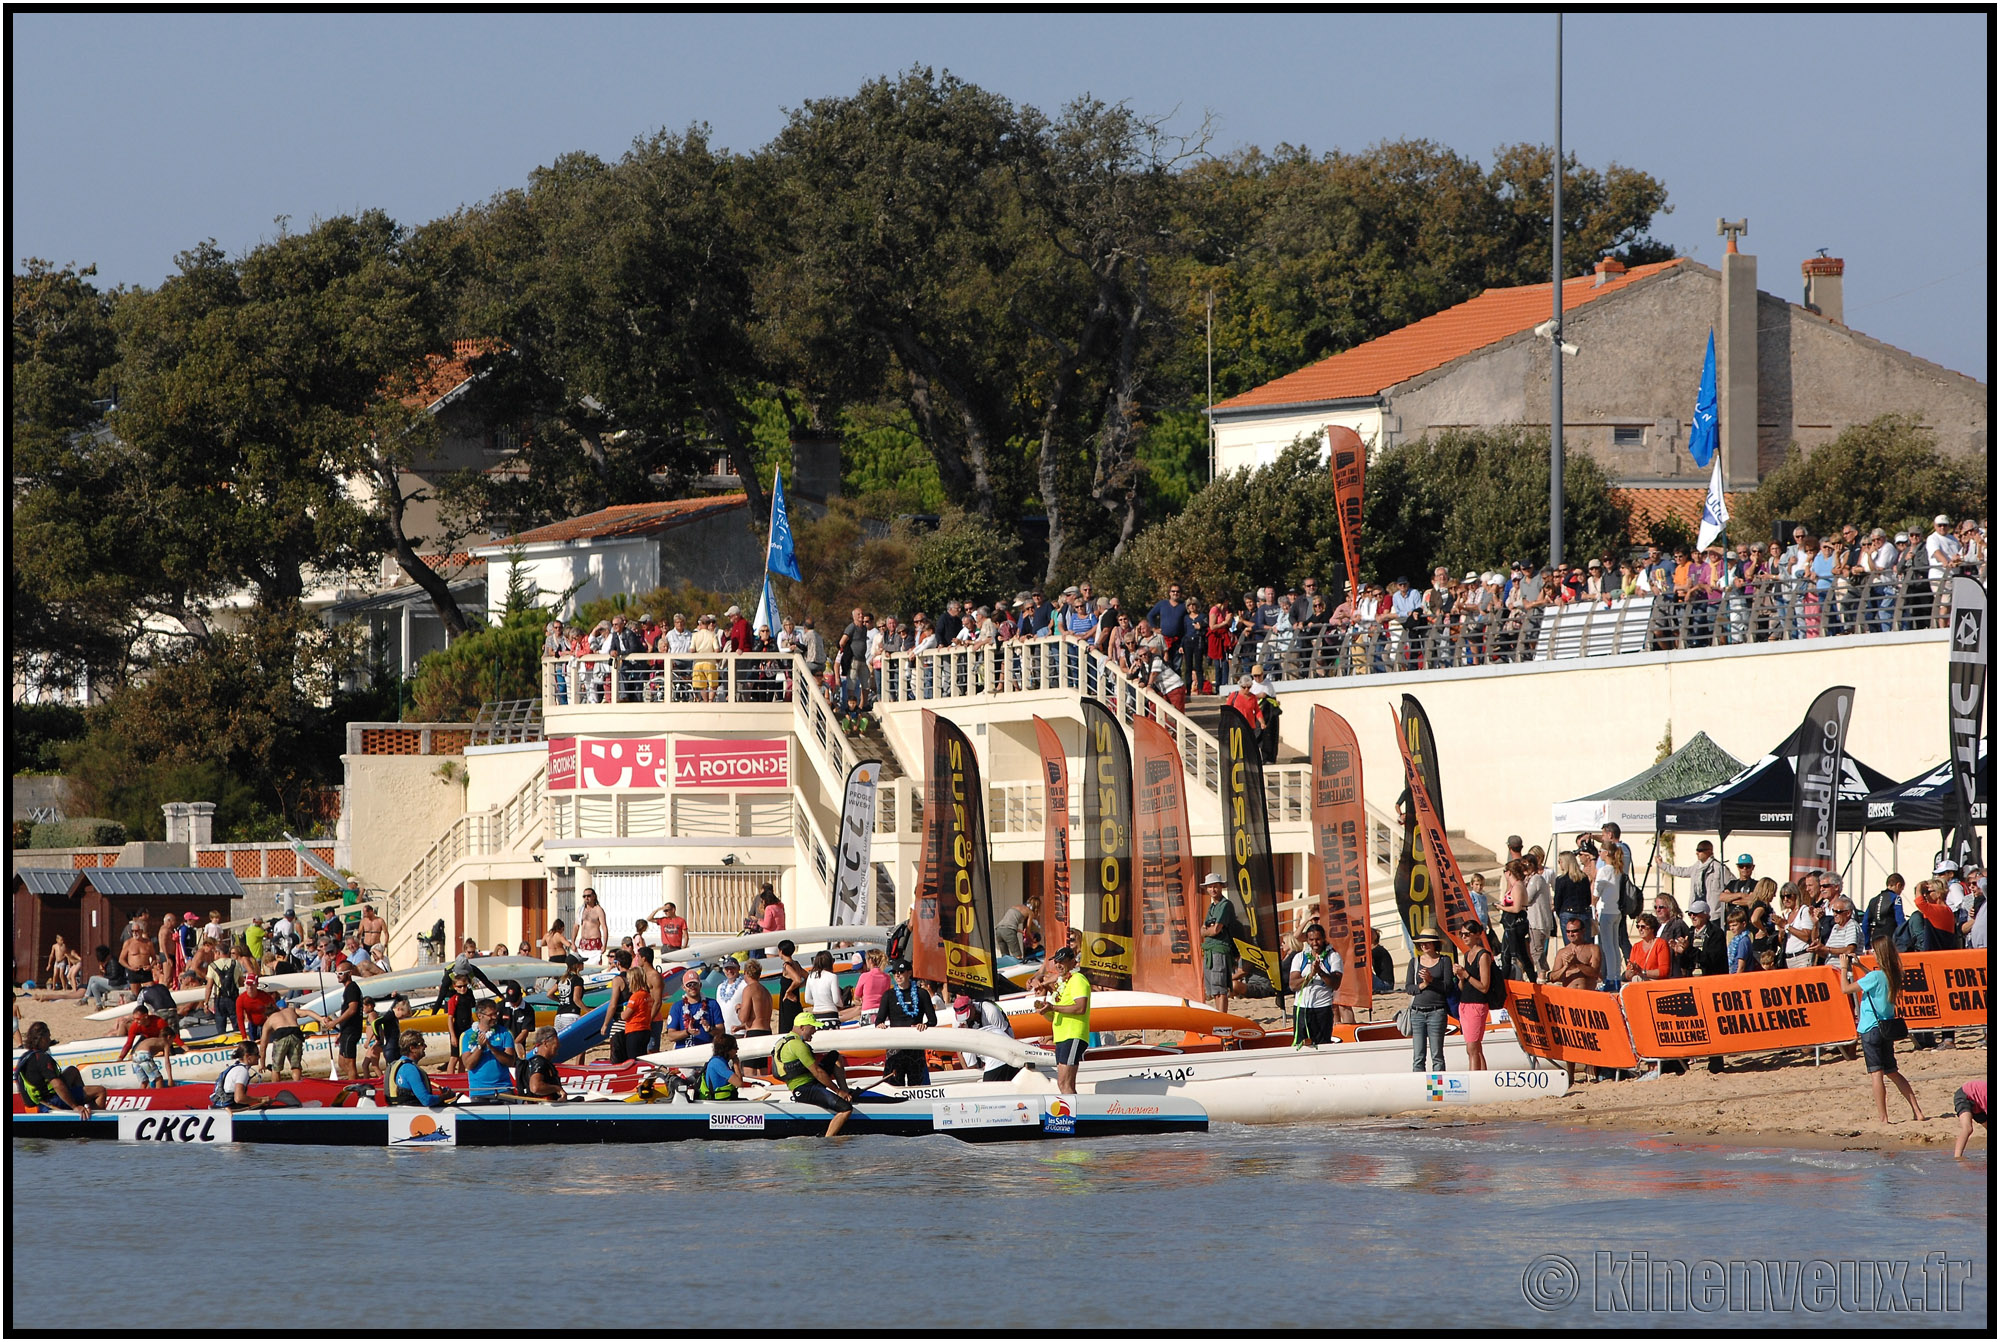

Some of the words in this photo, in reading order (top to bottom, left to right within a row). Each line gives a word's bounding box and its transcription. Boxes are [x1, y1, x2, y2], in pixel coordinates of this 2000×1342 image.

[1712, 989, 1752, 1012] FORT
[1760, 982, 1830, 1008] BOYARD
[1545, 1003, 1568, 1026] FORT
[1570, 1007, 1609, 1031] BOYARD
[1657, 1020, 1674, 1031] FORT
[1675, 1019, 1705, 1030] BOYARD
[1717, 1007, 1810, 1035] CHALLENGE
[1551, 1026, 1601, 1052] CHALLENGE
[1658, 1030, 1708, 1044] CHALLENGE
[91, 1064, 126, 1080] BAIE
[1494, 1071, 1549, 1089] 6E500
[135, 1116, 215, 1142] CKCL
[711, 1114, 763, 1125] SUNFORM
